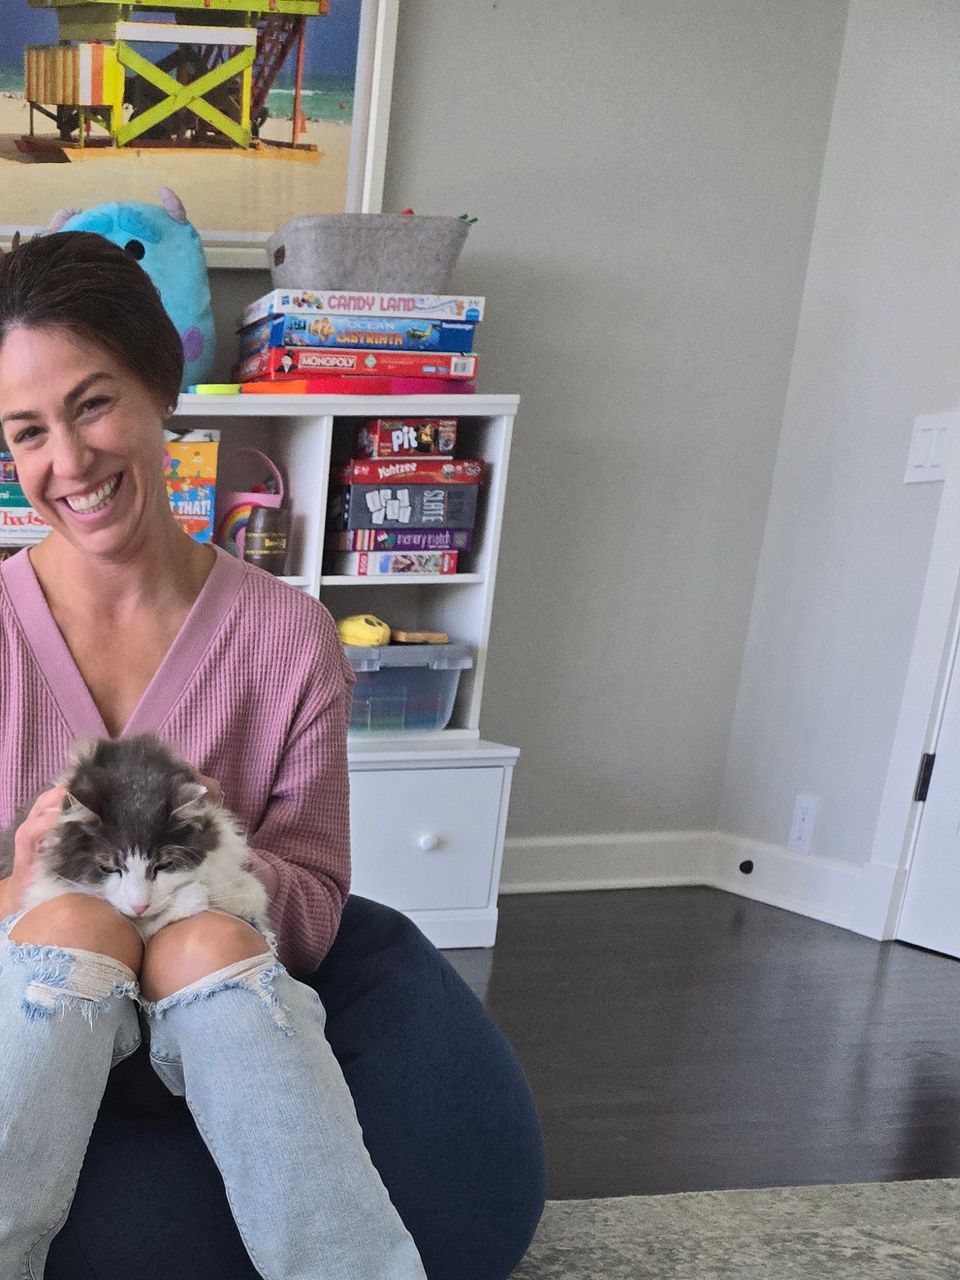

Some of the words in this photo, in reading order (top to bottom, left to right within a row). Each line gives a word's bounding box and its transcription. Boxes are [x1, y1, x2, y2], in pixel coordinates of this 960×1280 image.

[327, 295, 376, 311] CANDY
[380, 296, 417, 312] LAND
[302, 355, 356, 368] MONOPOLY
[392, 425, 418, 452] pit
[179, 499, 212, 515] THAT!
